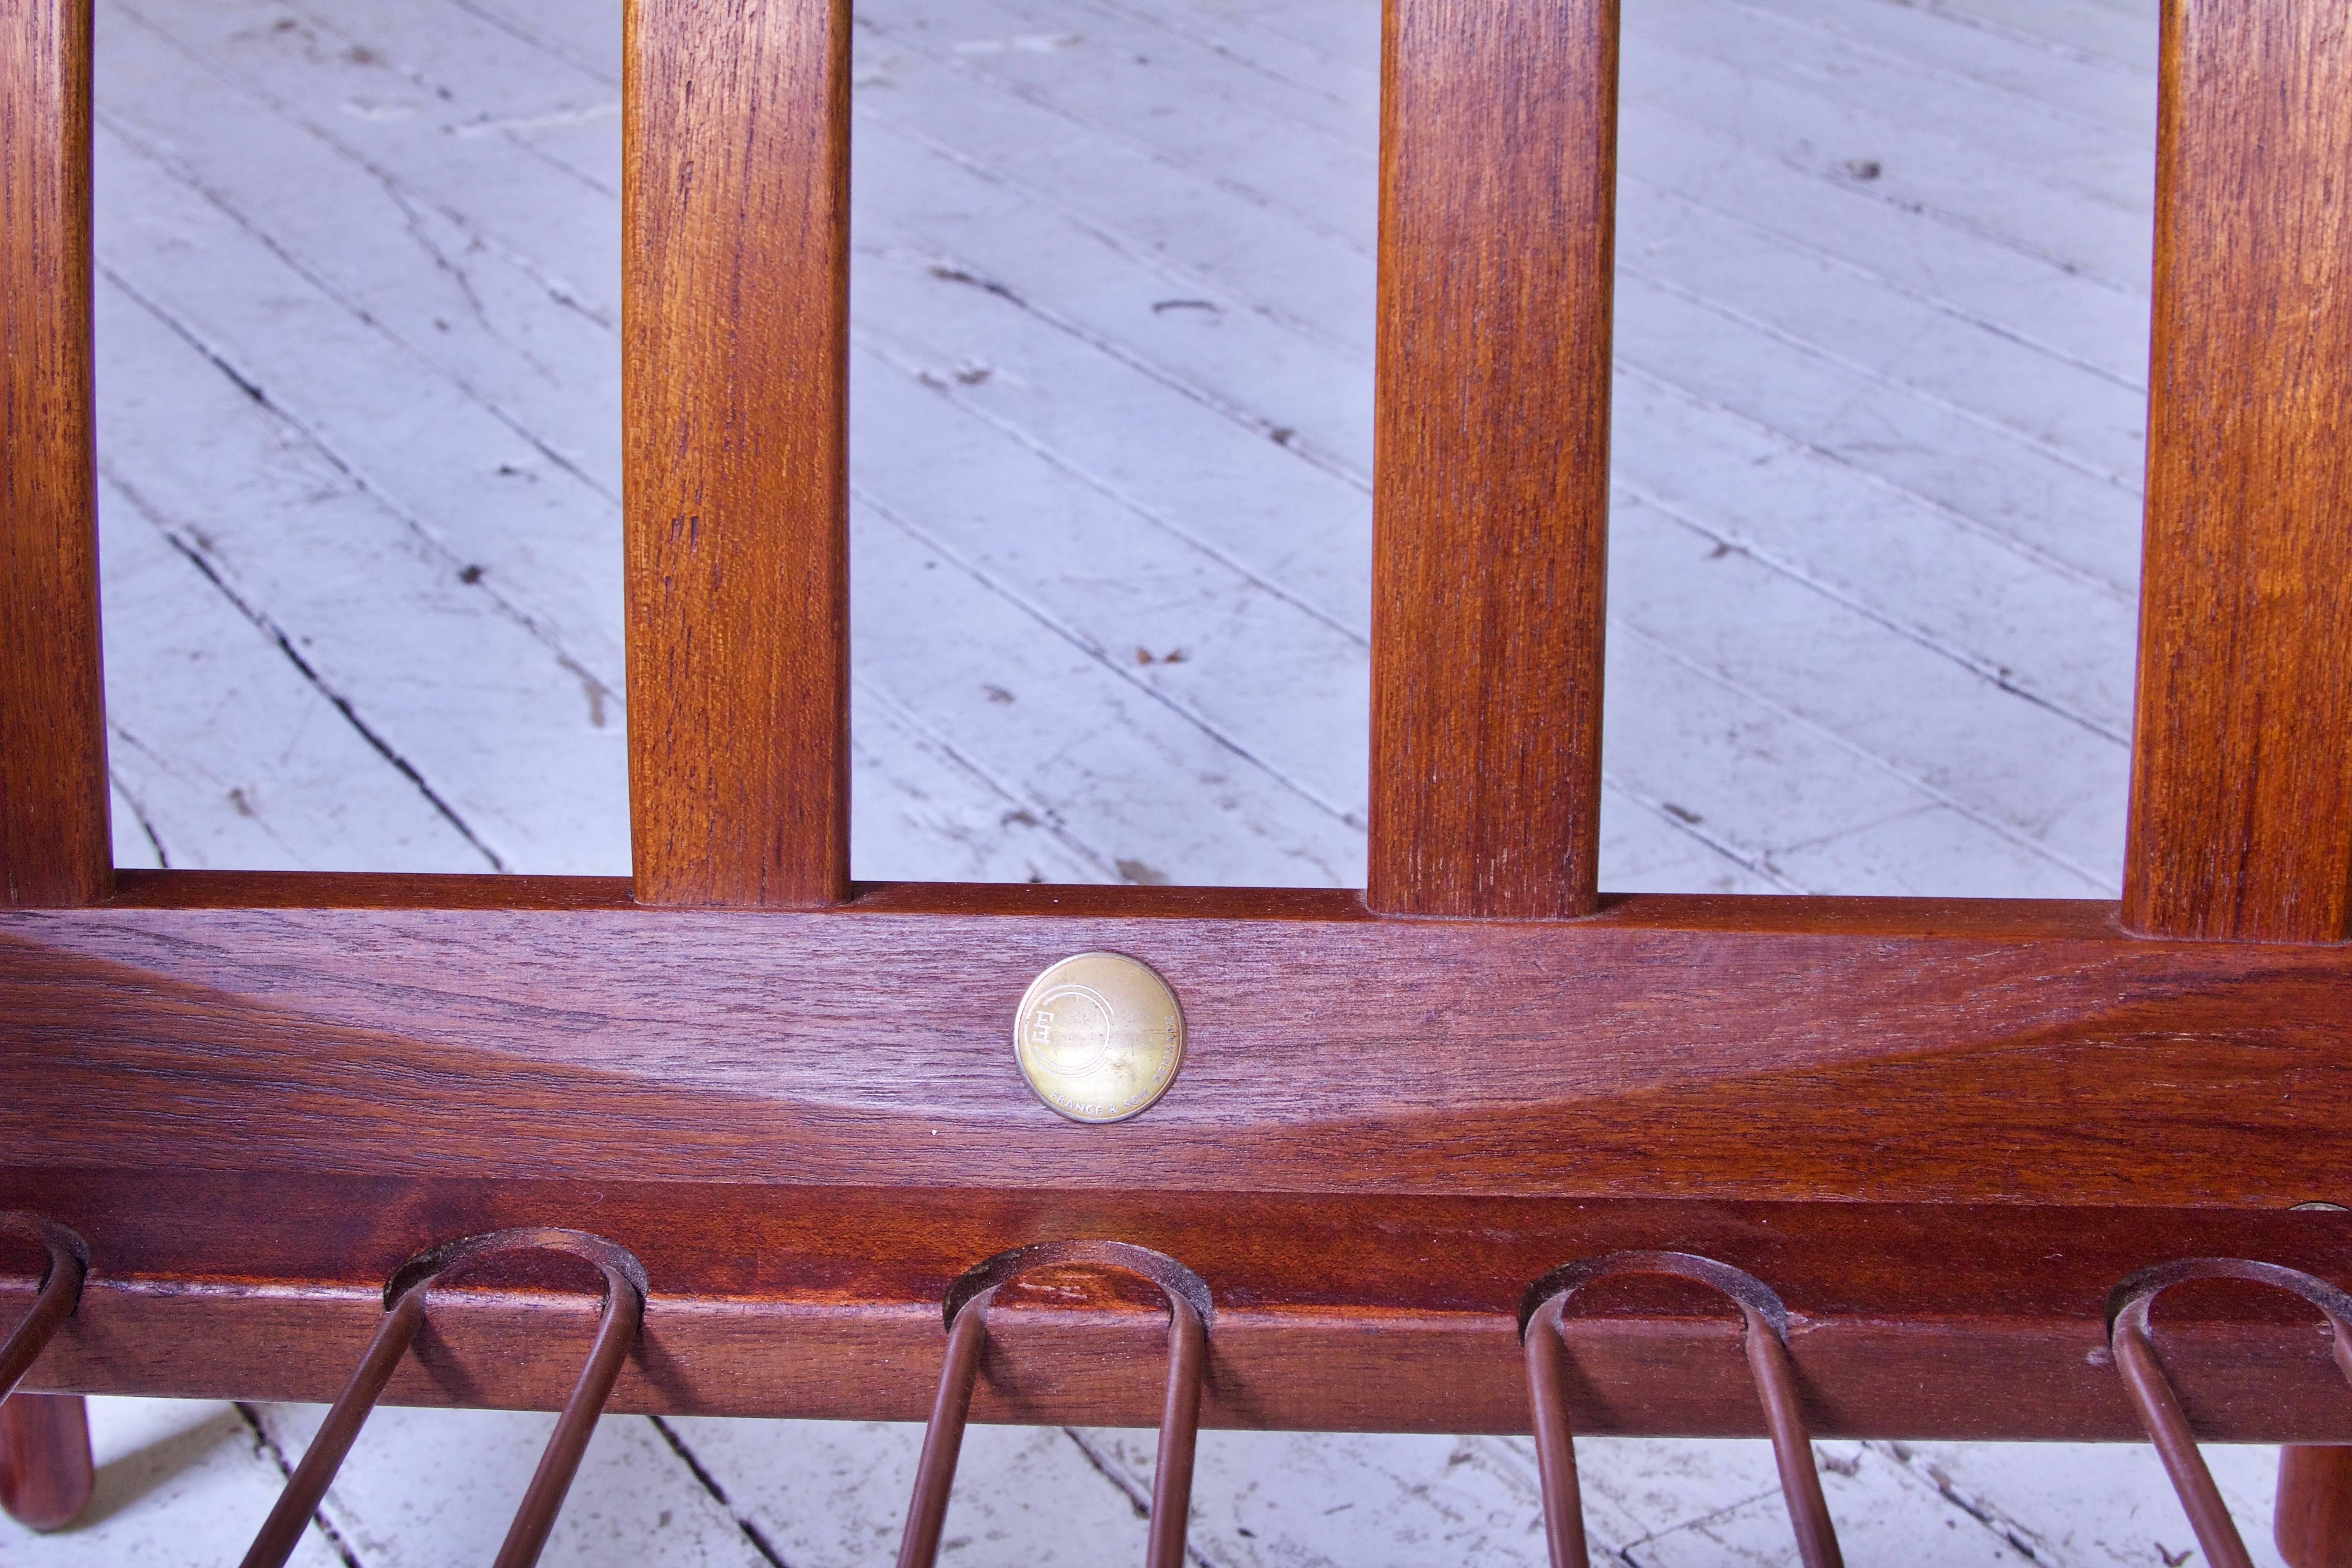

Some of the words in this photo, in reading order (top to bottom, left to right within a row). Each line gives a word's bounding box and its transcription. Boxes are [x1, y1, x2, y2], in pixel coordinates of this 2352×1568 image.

[1050, 1090, 1102, 1116] FRANCE
[1110, 1104, 1118, 1114] &
[1124, 1088, 1151, 1109] SON
[1152, 1015, 1176, 1085] DENMARK
